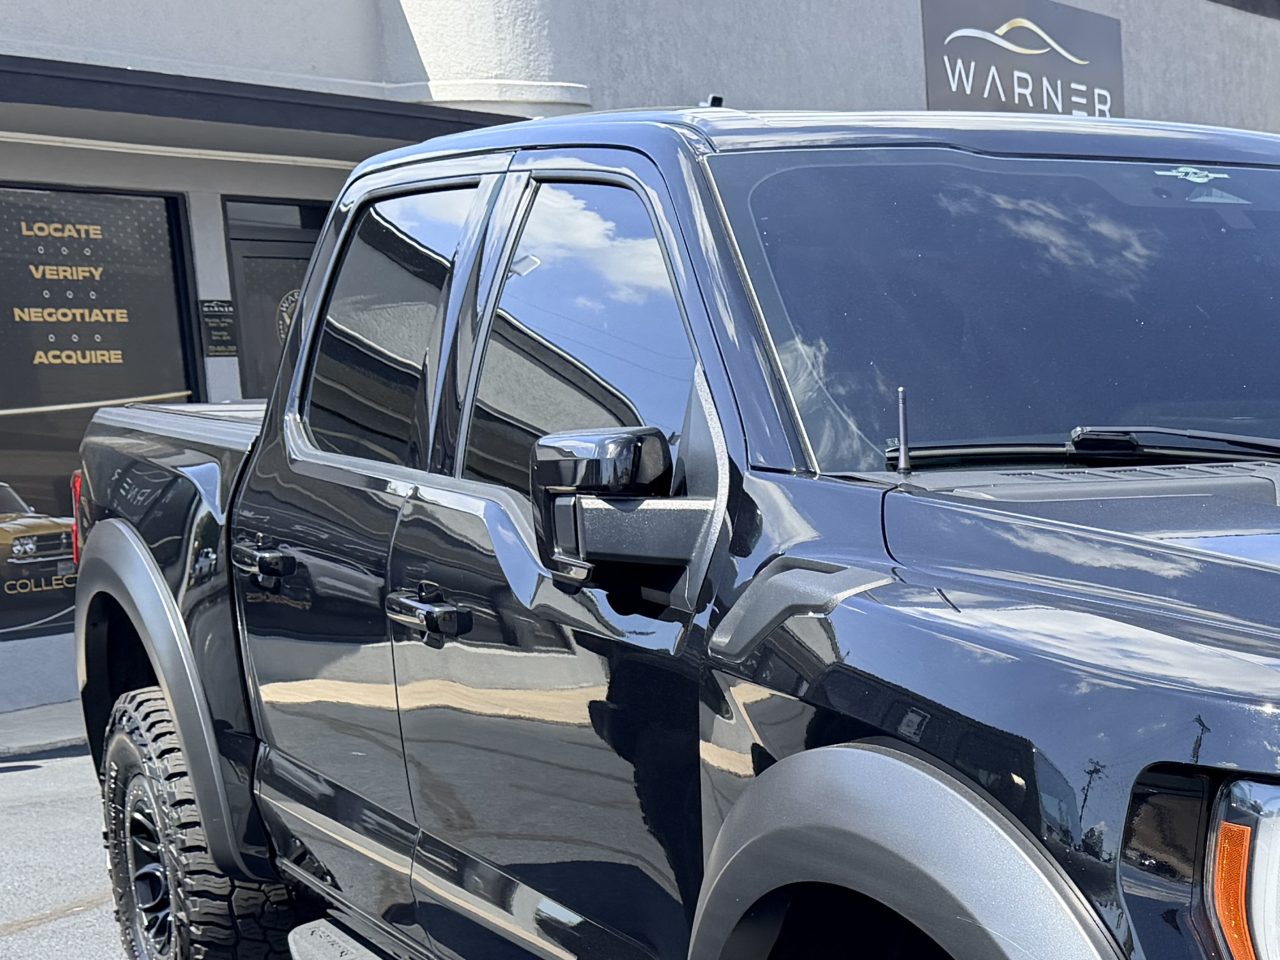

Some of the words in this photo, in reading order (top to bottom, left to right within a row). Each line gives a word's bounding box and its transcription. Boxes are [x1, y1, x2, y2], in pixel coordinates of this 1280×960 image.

[943, 55, 1112, 118] WARNER
[20, 221, 103, 239] LOCATE
[29, 264, 104, 281] VERIFY
[13, 307, 129, 323] NEGOTIATE
[33, 350, 124, 365] ACQUIRE
